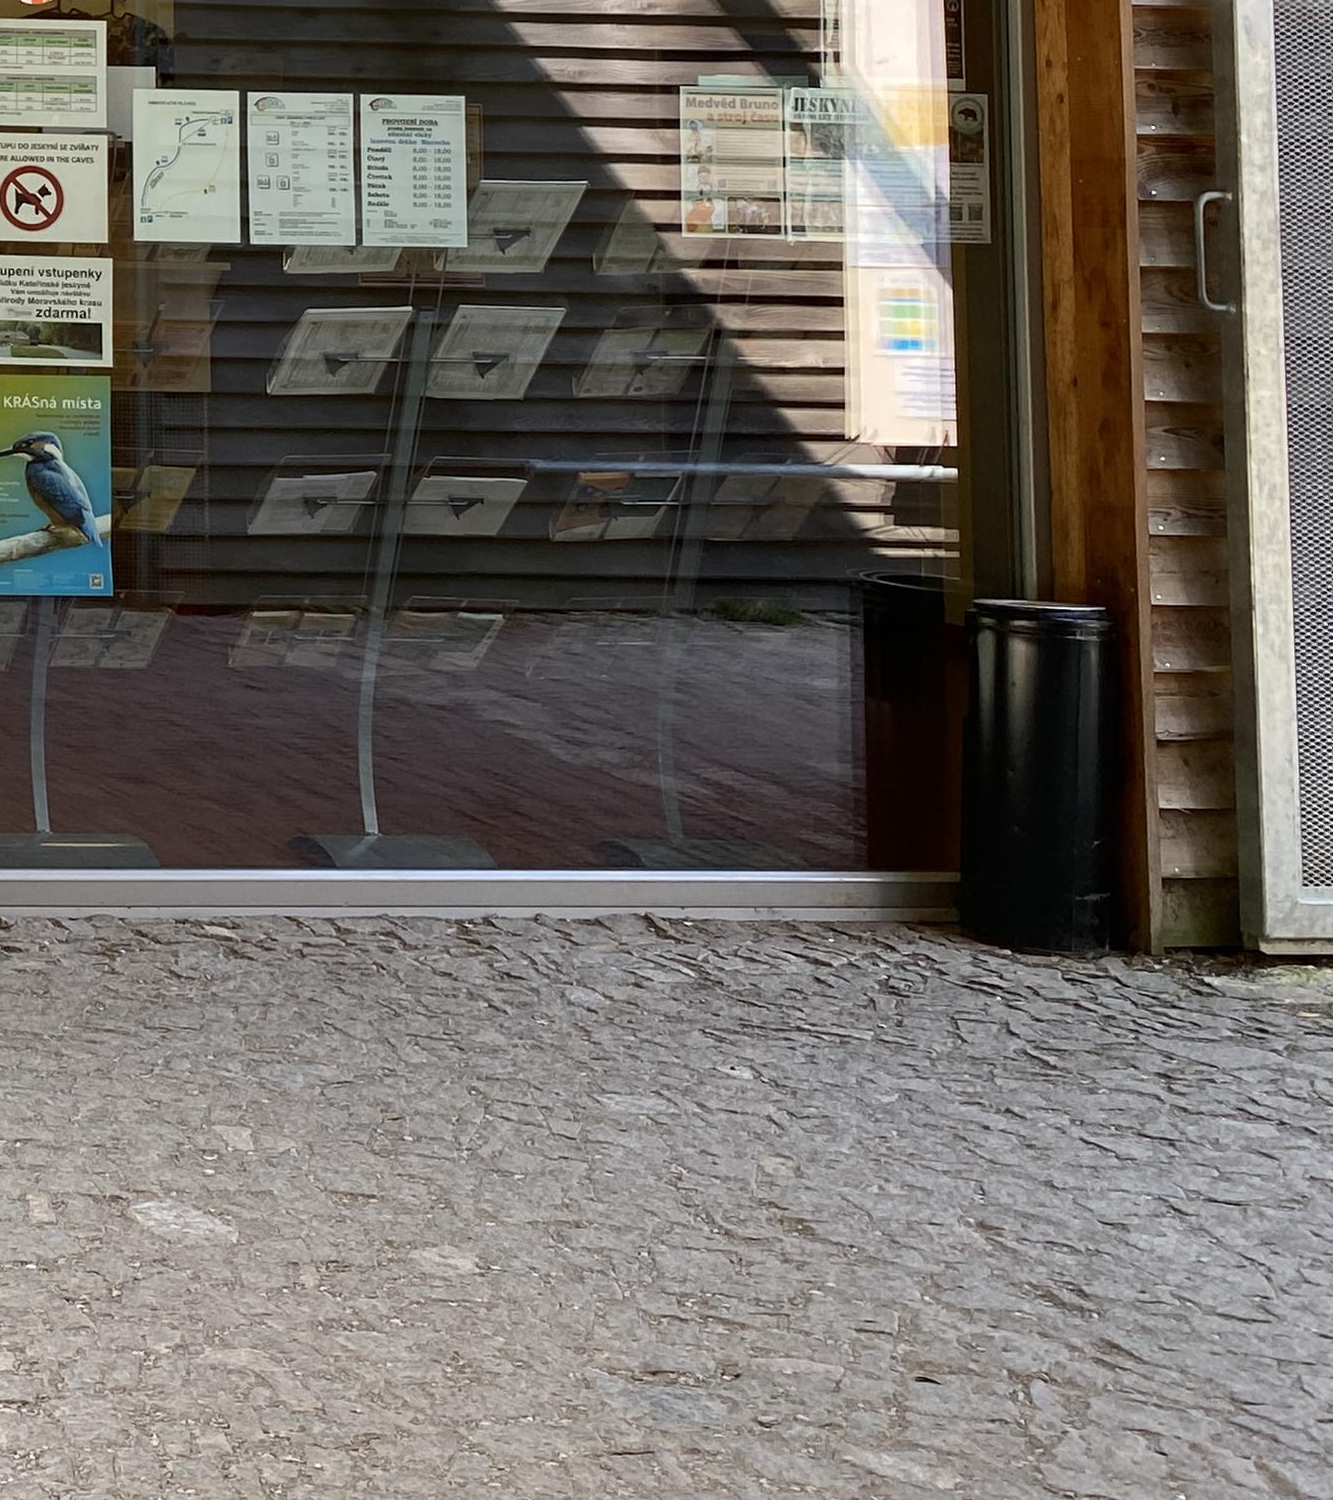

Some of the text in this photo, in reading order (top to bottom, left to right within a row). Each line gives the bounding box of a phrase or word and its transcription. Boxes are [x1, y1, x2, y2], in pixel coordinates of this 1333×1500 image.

[685, 97, 779, 110] Medvěd Bruno
[31, 141, 58, 151] JESKYNÍ
[69, 142, 100, 152] ZVÍŘATY
[71, 156, 95, 164] CAVES
[38, 267, 102, 281] vstupenky
[27, 297, 77, 306] Moravského
[79, 299, 102, 307] krasu
[35, 307, 91, 319] zdarma!
[3, 393, 102, 410] KRÁSná místa
